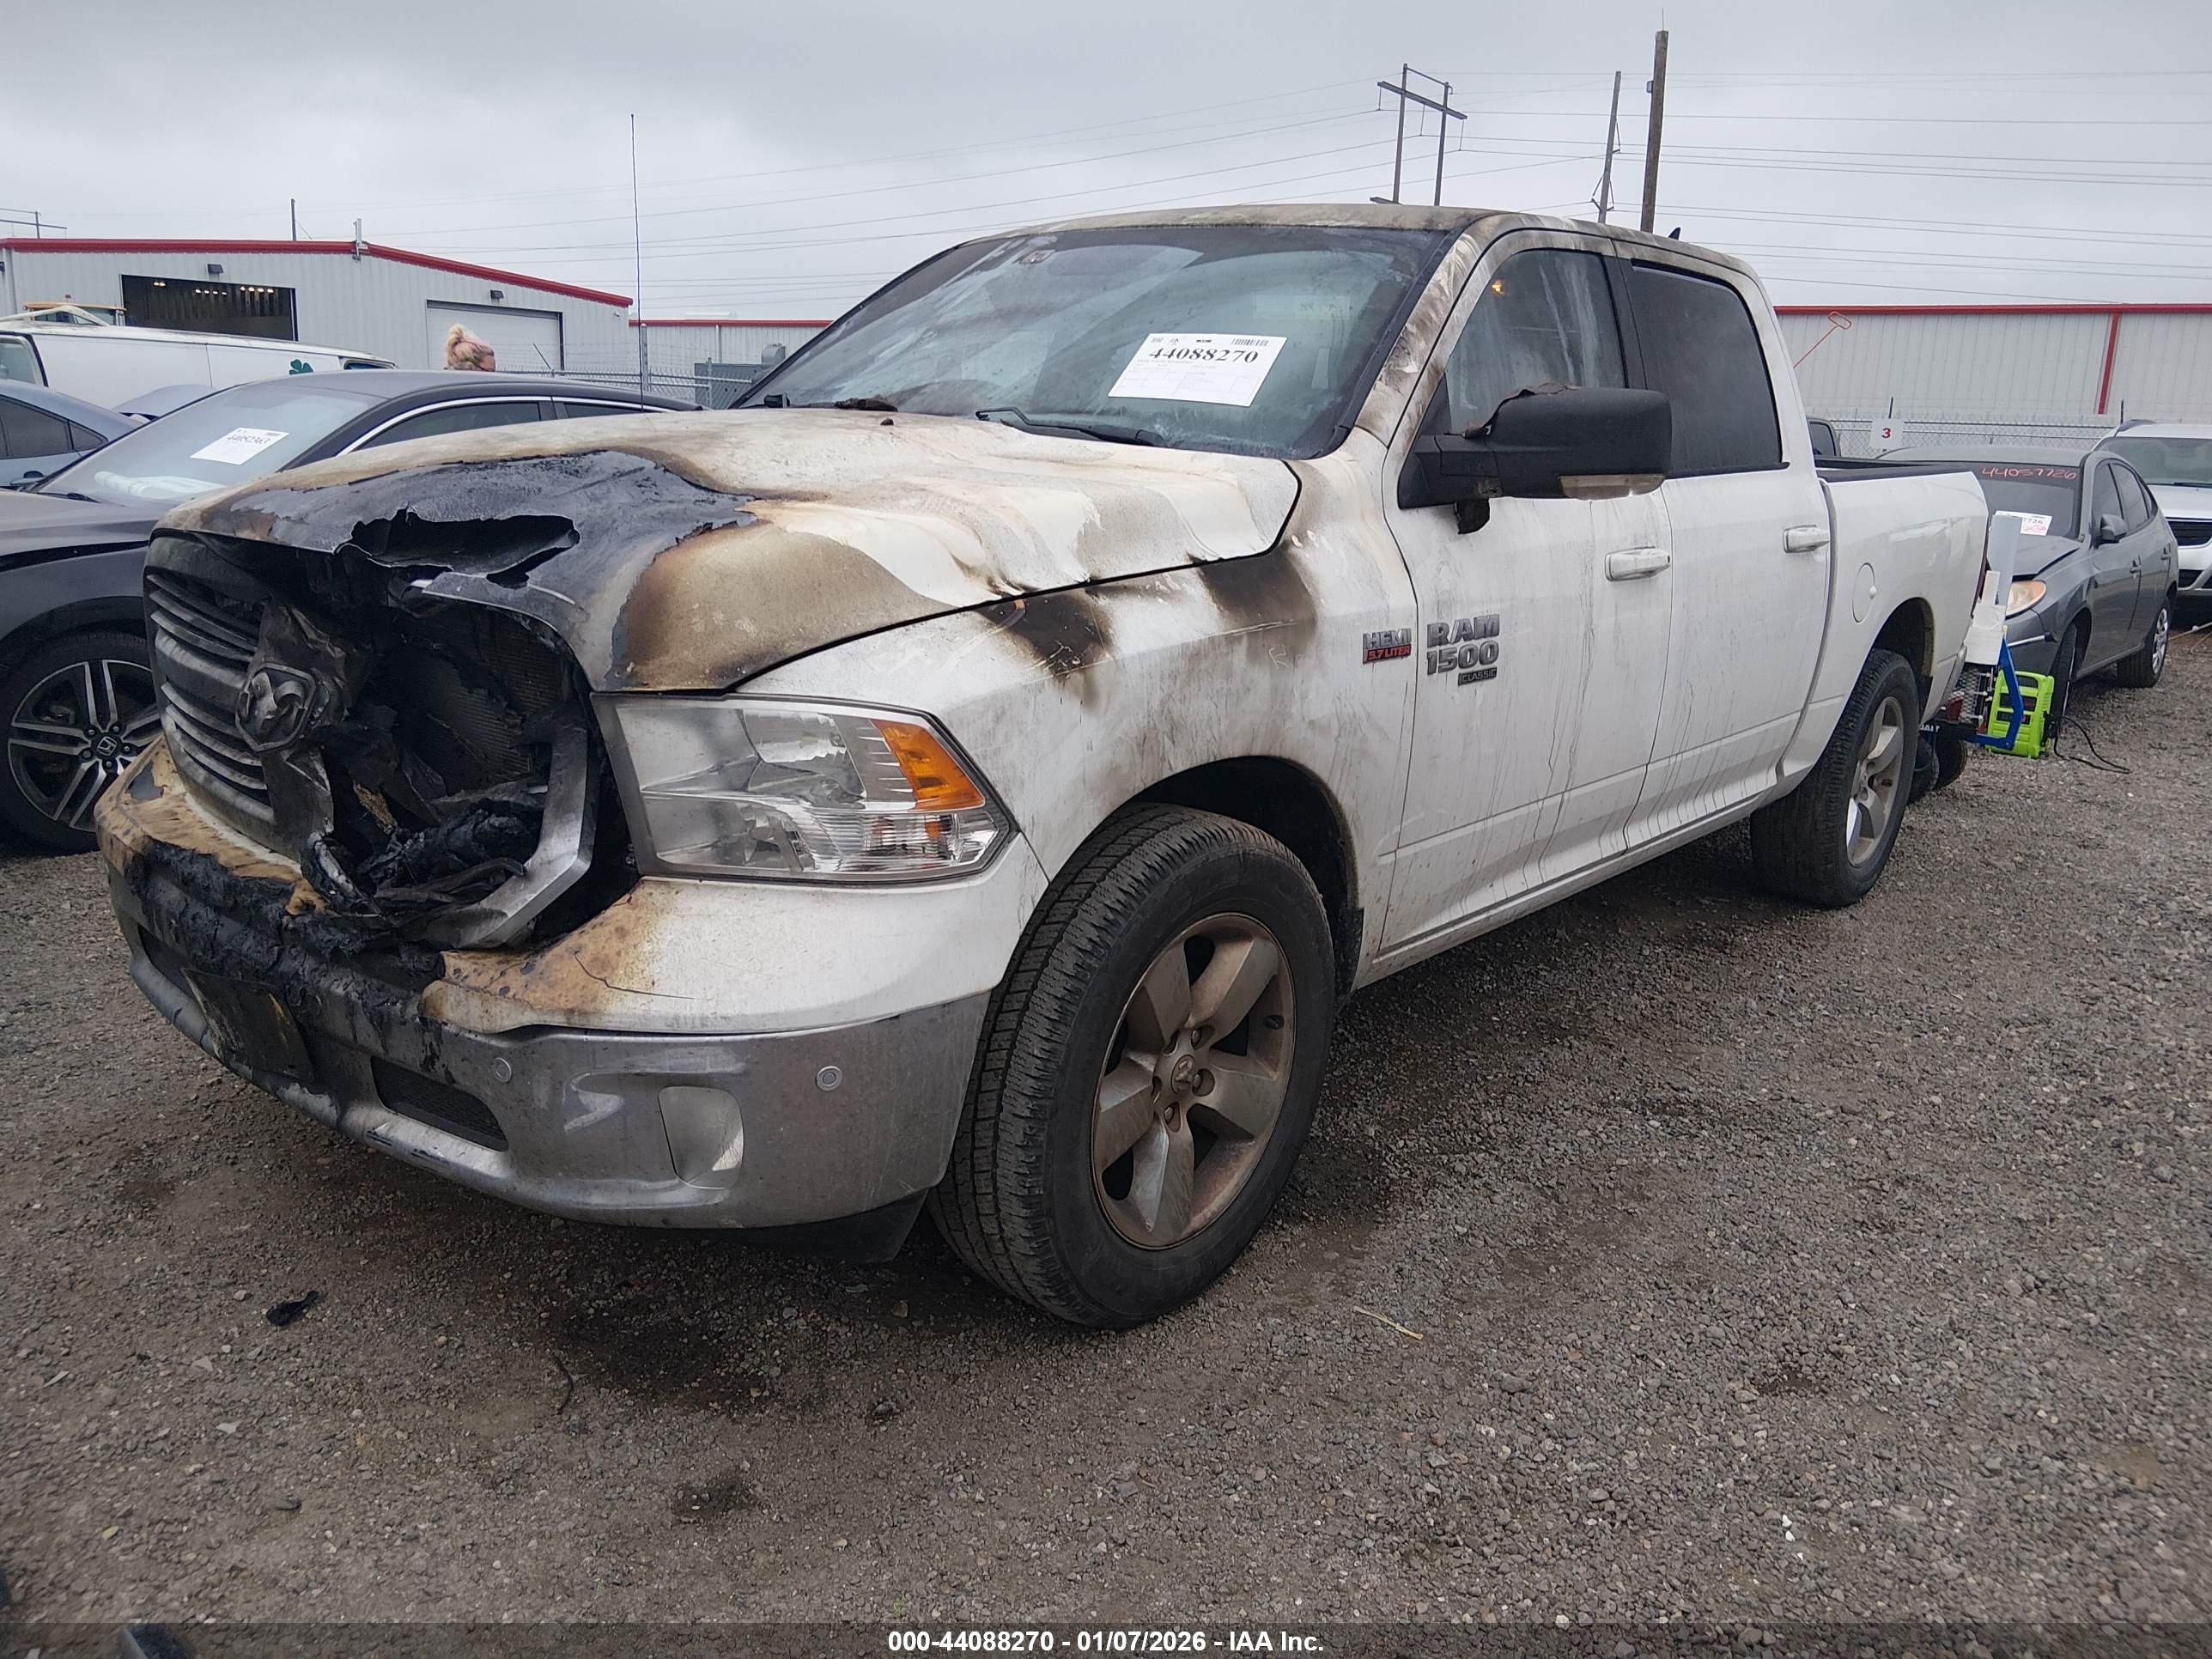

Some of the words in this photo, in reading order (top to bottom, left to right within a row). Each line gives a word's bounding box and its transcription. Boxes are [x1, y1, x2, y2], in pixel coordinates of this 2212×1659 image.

[1149, 346, 1260, 364] 44088270
[1881, 427, 1892, 439] 3
[1363, 628, 1412, 650] HEMI
[1427, 614, 1500, 647] RAM
[1384, 645, 1411, 659] LITER
[1427, 640, 1500, 676] 1500
[1460, 667, 1498, 684] CLASSIC
